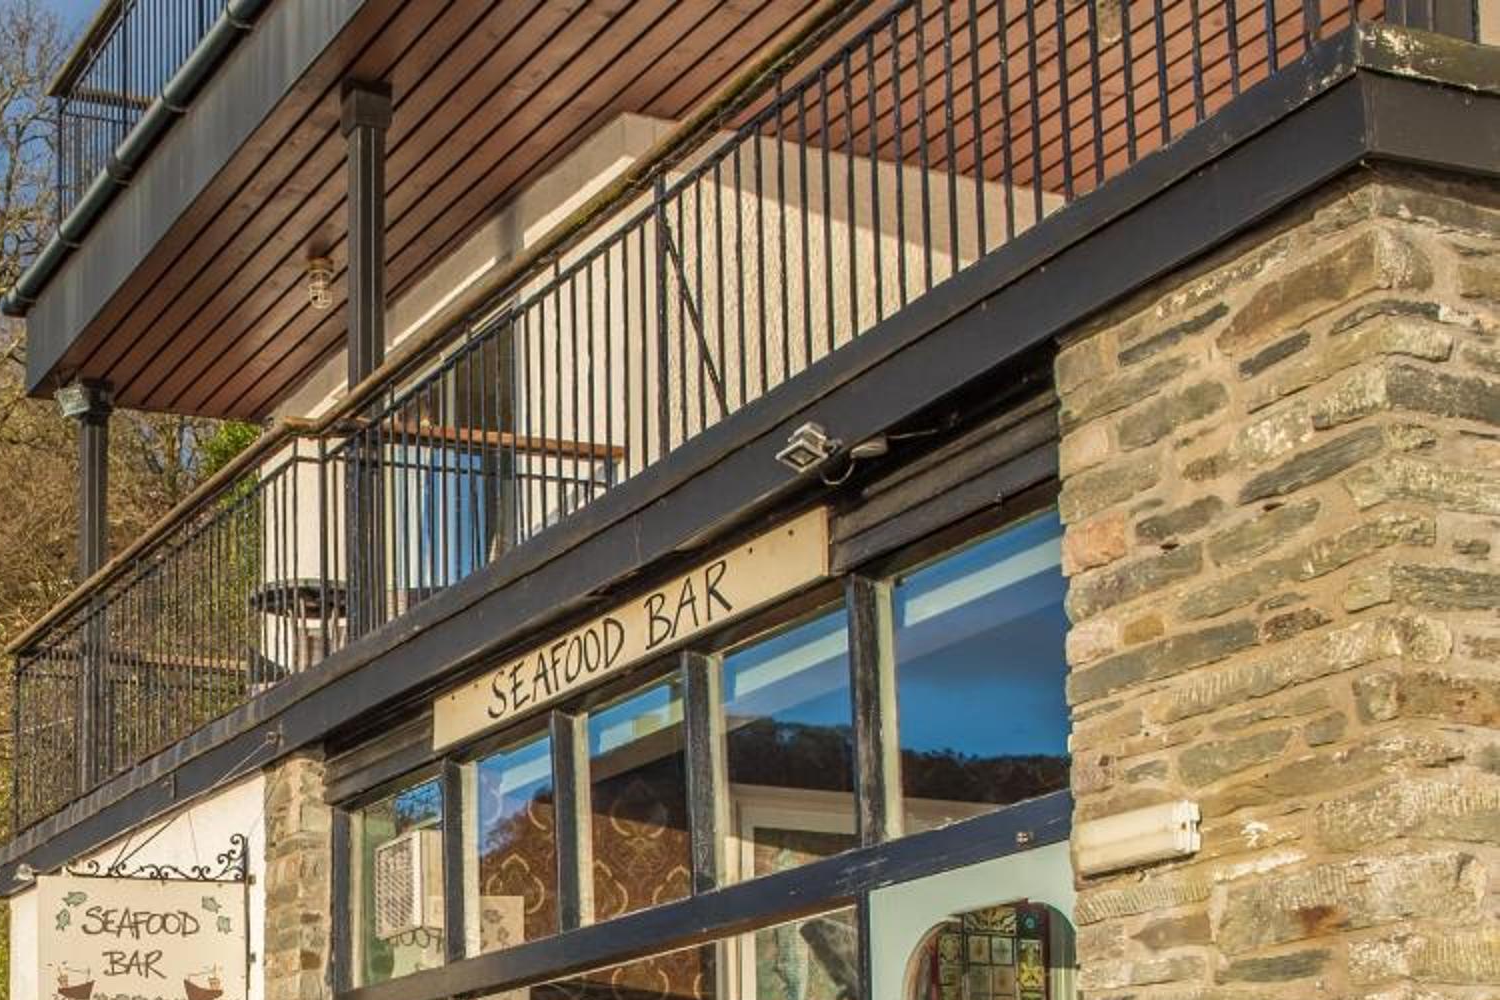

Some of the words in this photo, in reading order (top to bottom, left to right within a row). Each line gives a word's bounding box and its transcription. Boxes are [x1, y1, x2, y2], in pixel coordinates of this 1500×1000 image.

[487, 618, 625, 719] SEAFOOD
[643, 559, 734, 651] BAR
[82, 906, 200, 939] SEAFOOD
[102, 949, 167, 979] BAR
